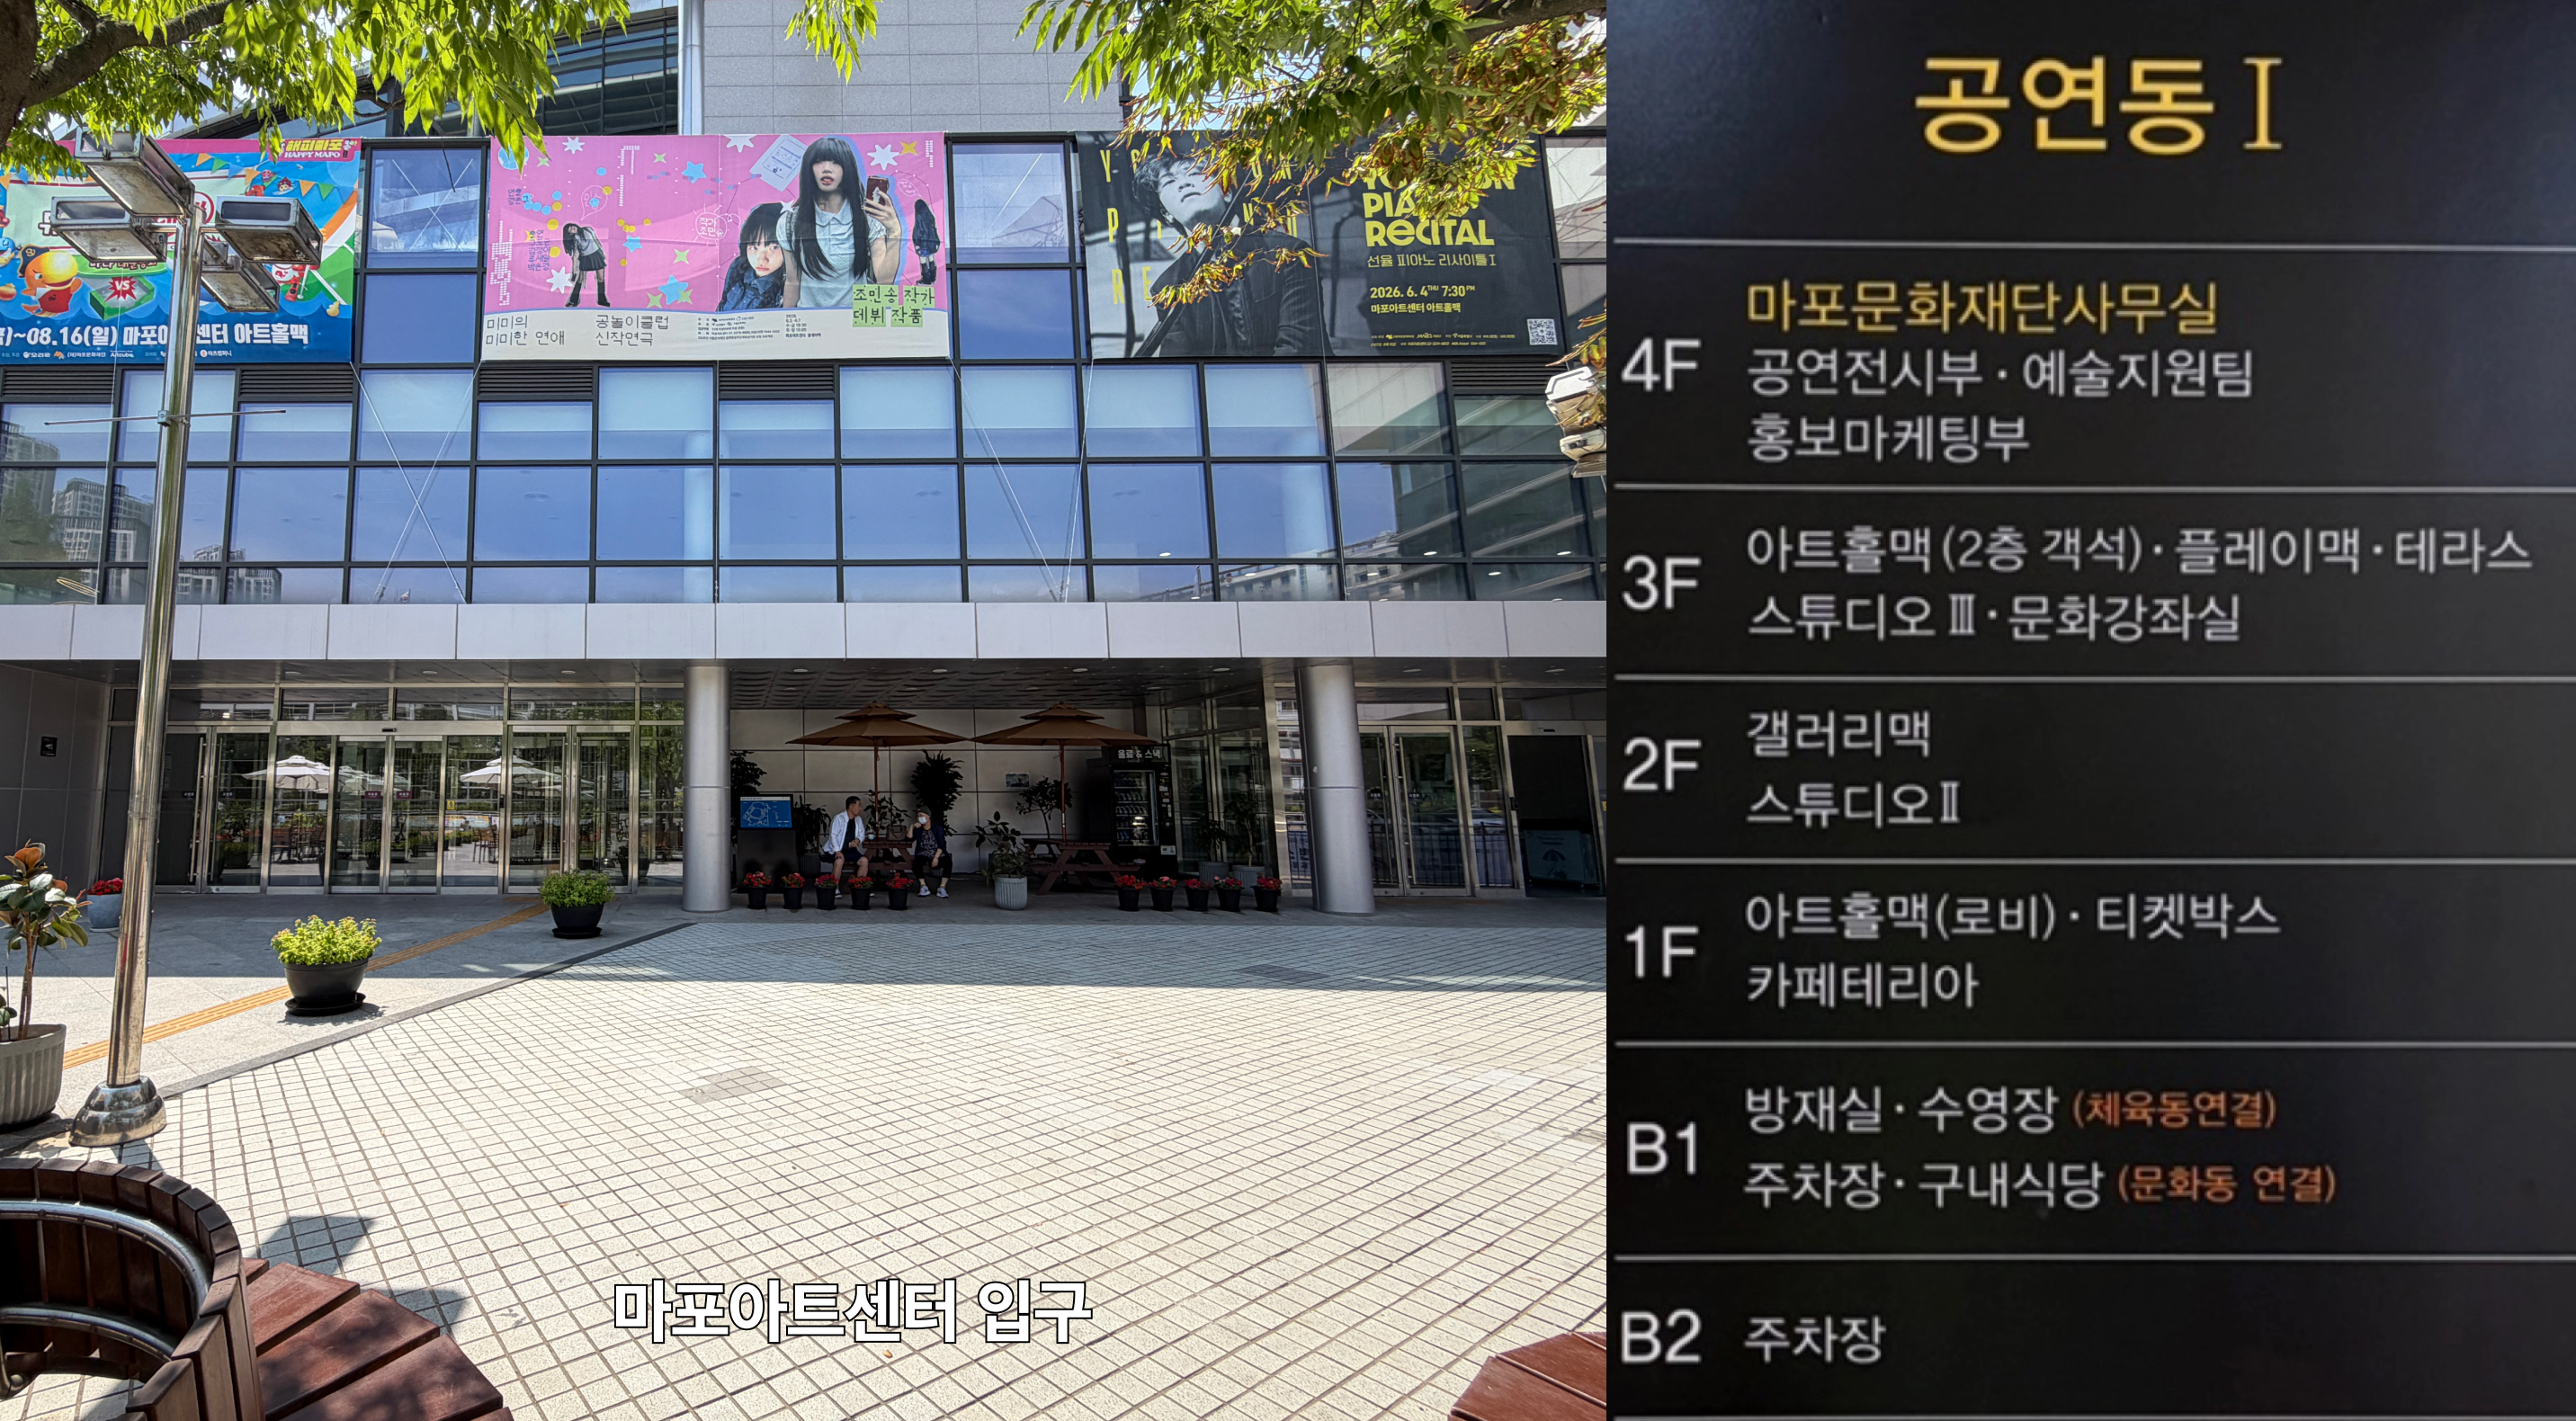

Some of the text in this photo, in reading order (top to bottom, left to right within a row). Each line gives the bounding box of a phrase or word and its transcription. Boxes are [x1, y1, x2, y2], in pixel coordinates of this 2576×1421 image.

[1915, 57, 2214, 155] 공연동
[1367, 255, 1394, 268] 선율
[1397, 254, 1436, 267] 피아노
[114, 280, 130, 291] VS
[853, 285, 935, 305] 조민송 작가
[1370, 286, 1404, 299] 2026.
[1406, 286, 1418, 297] 6.
[1371, 302, 1462, 315] 마포아트센터 아트홀맥
[1748, 279, 2216, 335] 마포문화재단사무실
[234, 323, 309, 344] 아트홀맥
[485, 329, 566, 346] 미미한 연애
[487, 315, 529, 331] 미미의
[595, 315, 669, 330] 공놀이클럽
[595, 330, 654, 347] 신작연극
[853, 306, 923, 325] 데뷔 작품
[1621, 337, 1701, 391] 4F
[1748, 348, 2252, 398] 공연전시부 예술지원팀
[1748, 413, 2030, 463] 홍보마케팅부
[2395, 527, 2533, 574] 테라스
[1623, 555, 1701, 611] 3F
[1749, 594, 1936, 641] 스튜디오
[2008, 594, 2240, 642] 문화강좌실
[1117, 748, 1160, 759] 음료 & 스낵
[1748, 710, 1929, 757] 갤러리맥
[1623, 737, 1702, 791] 2F
[2097, 893, 2280, 939] 티켓박스
[1626, 925, 1699, 978] 1F
[1749, 961, 1980, 1008] 카페테리아
[1747, 1086, 2276, 1133] 방재실 수영장 (체육동연결)
[1627, 1122, 1696, 1175] B1
[1744, 1162, 2336, 1209] 주차장 구내식당 (문화동 연결)
[1621, 1309, 1887, 1363] B2 주차장
